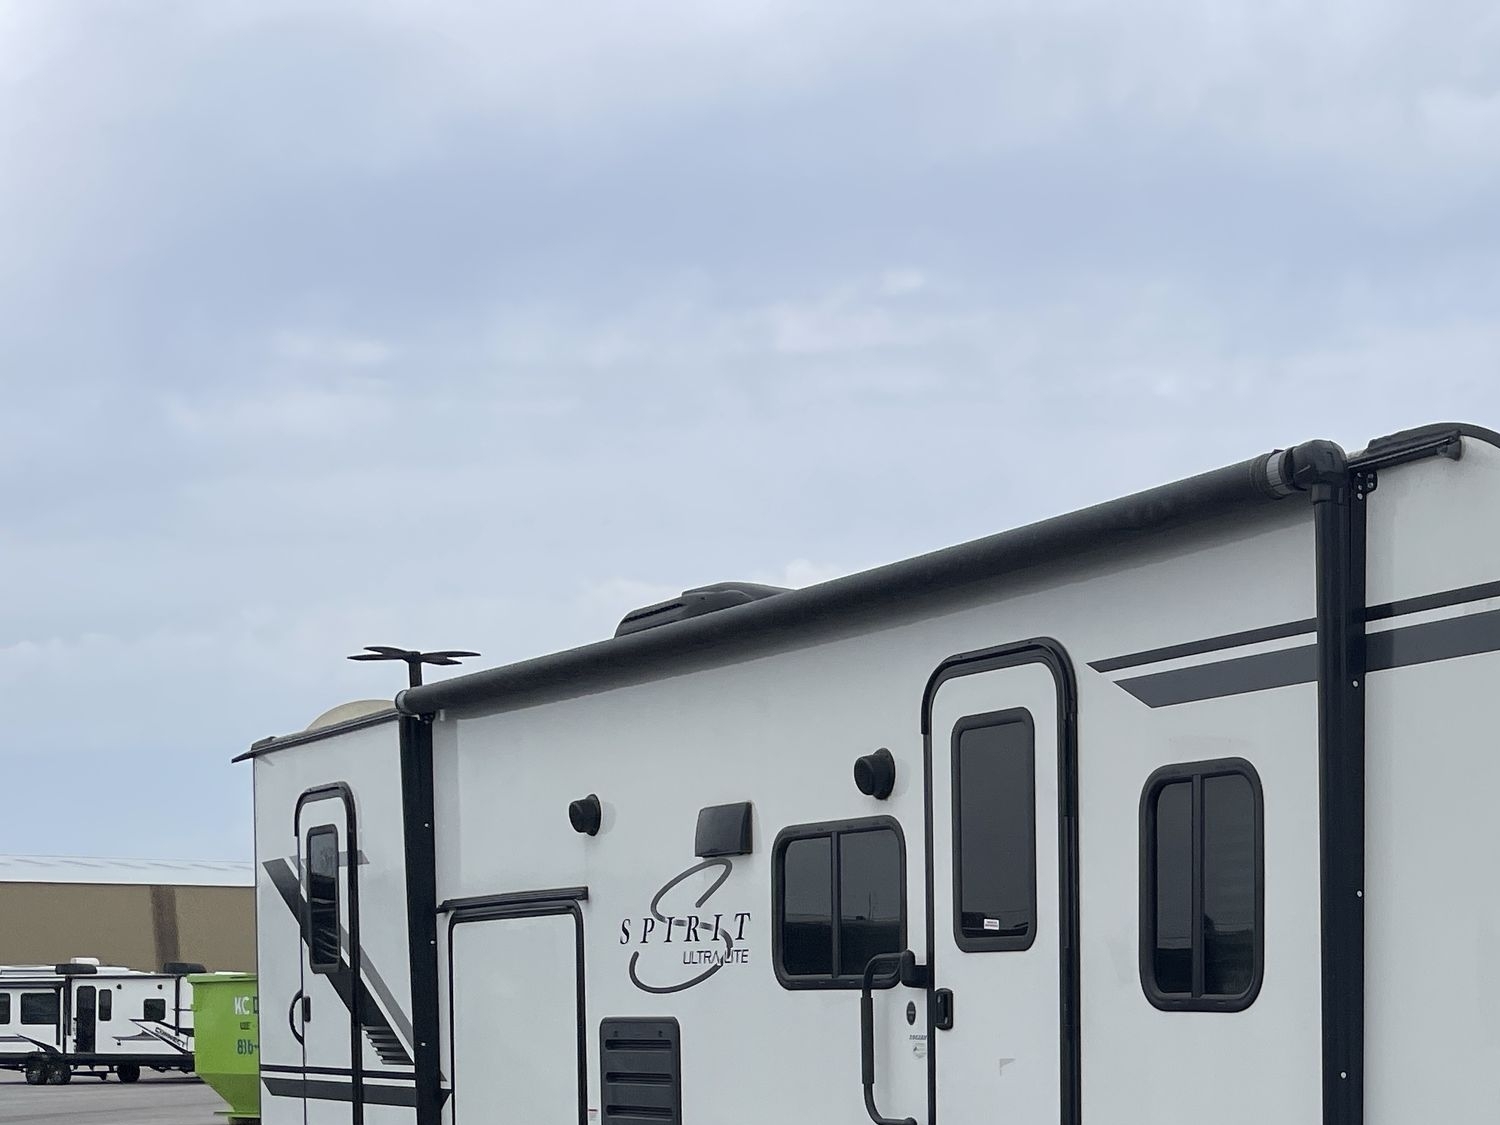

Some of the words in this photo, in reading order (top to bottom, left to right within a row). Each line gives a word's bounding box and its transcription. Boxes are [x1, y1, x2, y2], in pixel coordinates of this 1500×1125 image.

[619, 912, 751, 945] SPIRIT
[683, 950, 721, 965] ULTRA
[724, 949, 750, 964] LITE
[234, 996, 250, 1015] KC
